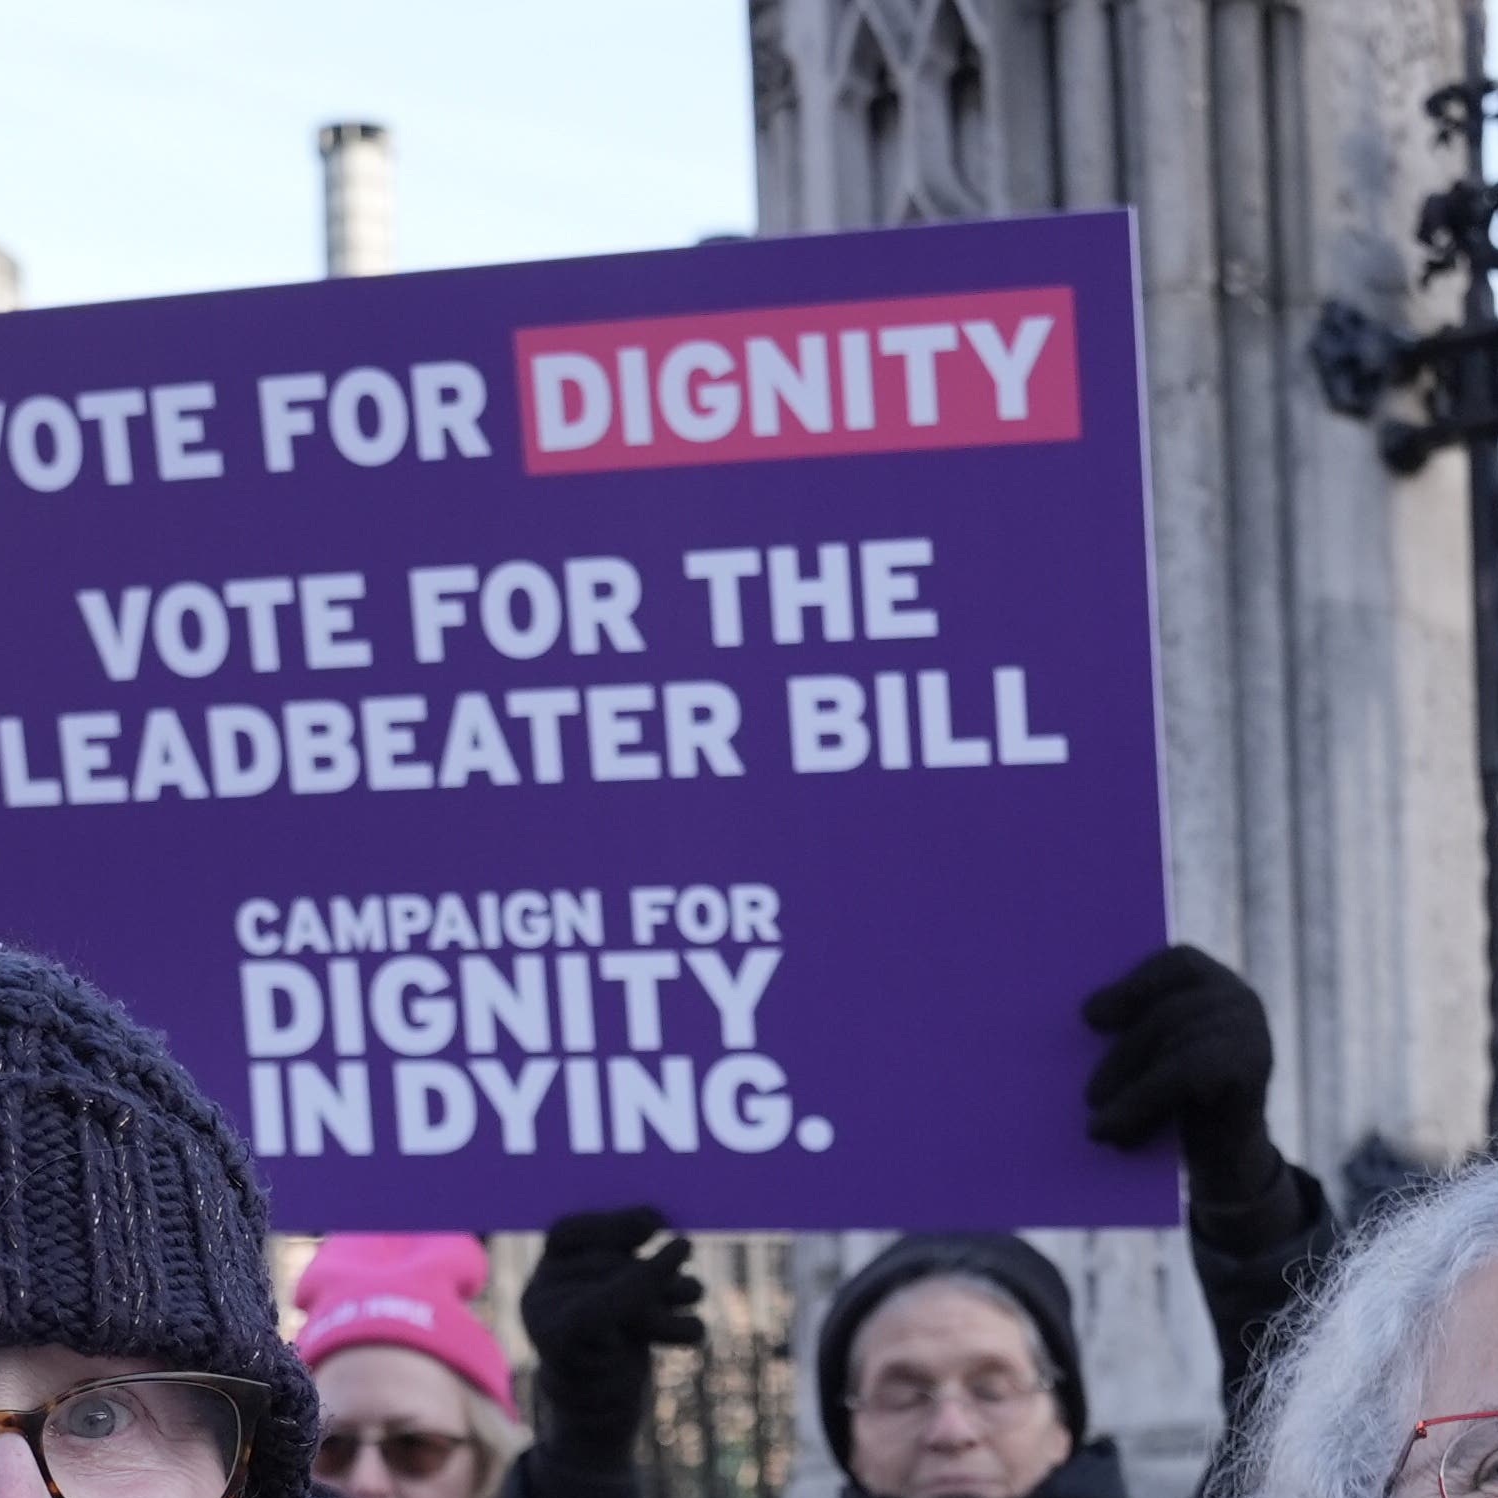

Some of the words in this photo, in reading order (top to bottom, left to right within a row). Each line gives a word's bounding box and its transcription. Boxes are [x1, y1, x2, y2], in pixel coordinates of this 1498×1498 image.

[257, 360, 492, 474] FOR
[529, 314, 1056, 454] DIGNITY
[75, 571, 374, 683] VOTE
[407, 555, 646, 665] FOR
[682, 536, 940, 649] THE
[786, 665, 1069, 775] BILL
[234, 888, 605, 957] CAMPAIGN
[629, 883, 782, 947] FOR
[239, 946, 784, 1060] DIGNITY
[248, 1060, 375, 1158] IN
[392, 1052, 835, 1158] DYING.
